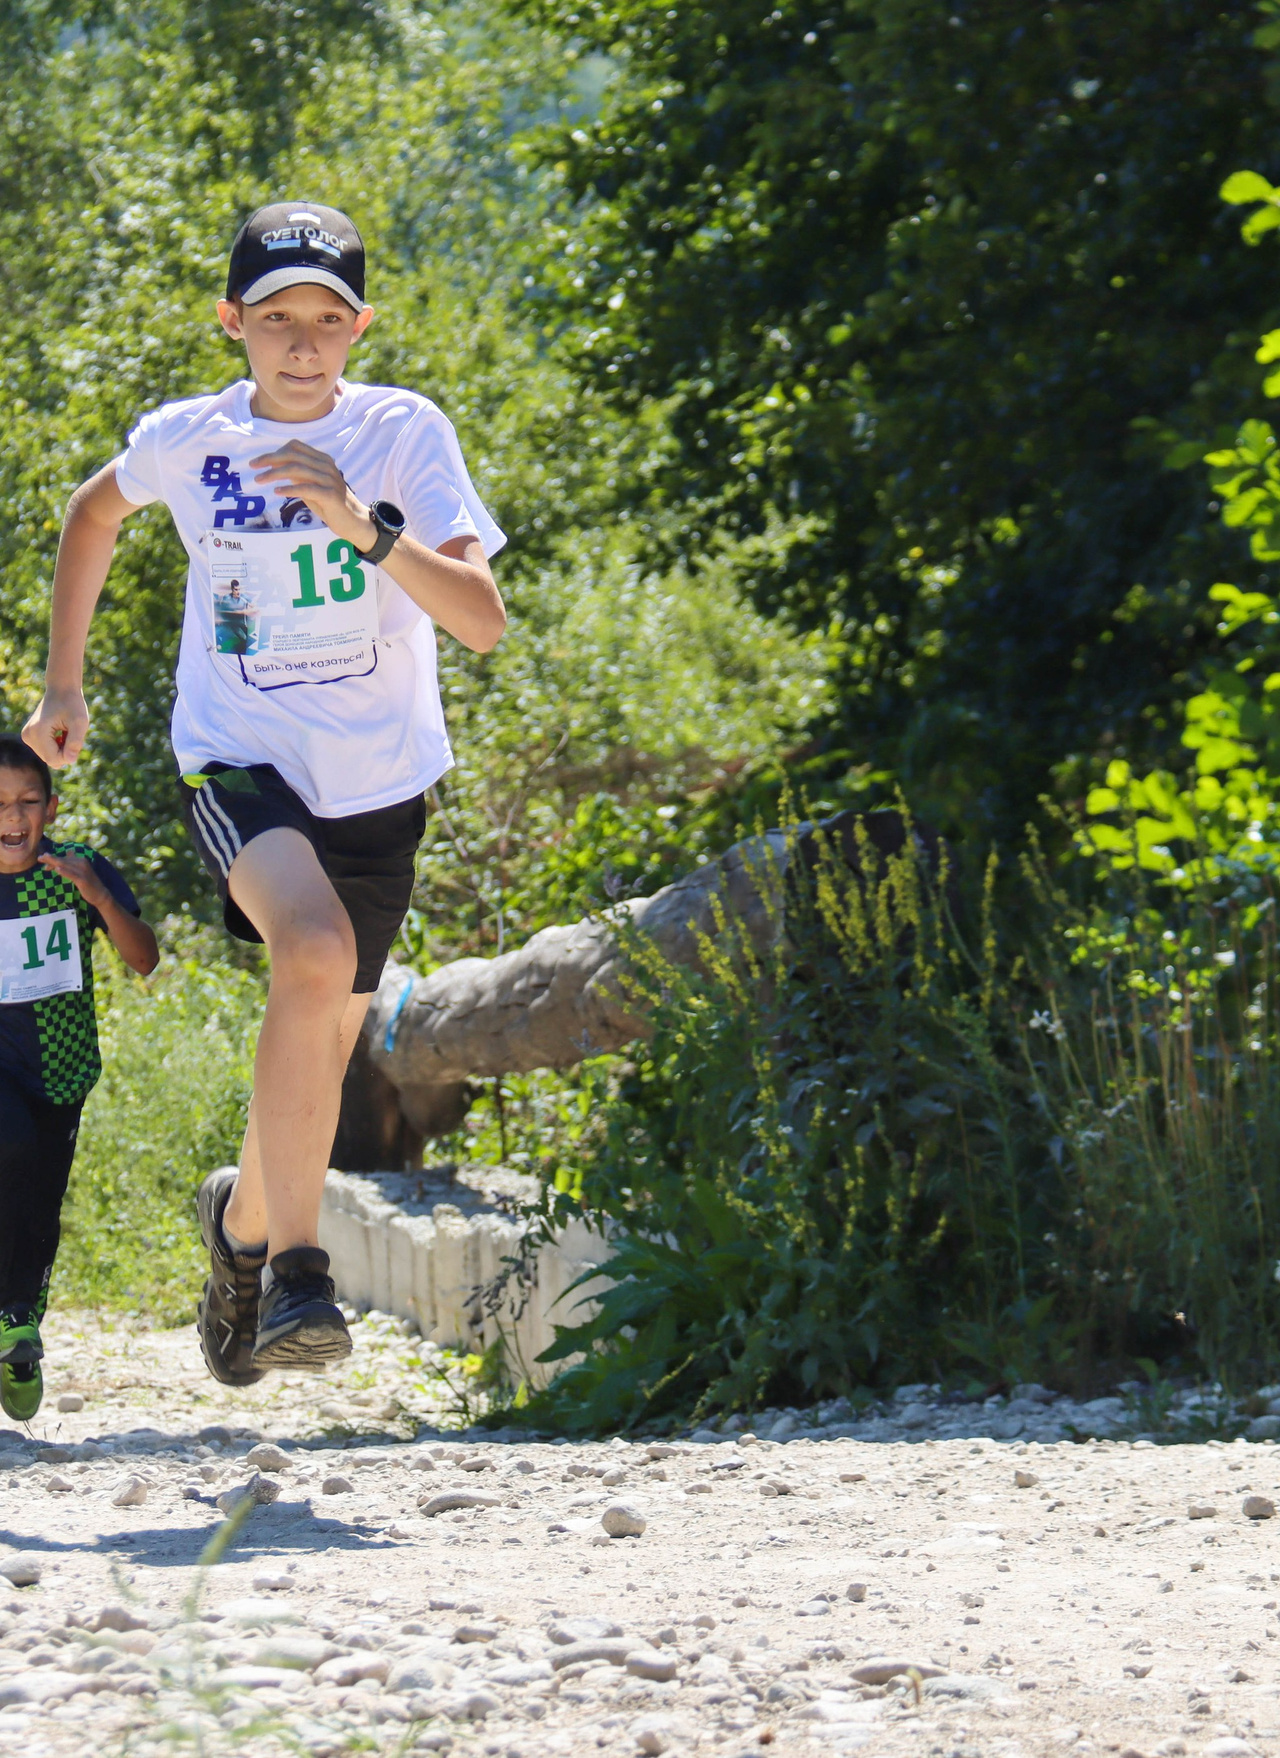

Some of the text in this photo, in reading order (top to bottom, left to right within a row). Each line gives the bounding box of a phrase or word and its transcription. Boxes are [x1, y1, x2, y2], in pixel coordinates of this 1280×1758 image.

[261, 226, 348, 251] СУЕТОЛОГ
[290, 538, 366, 609] 13
[284, 663, 293, 672] а
[294, 661, 308, 670] не
[310, 651, 365, 668] казаться!
[20, 918, 72, 970] 14
